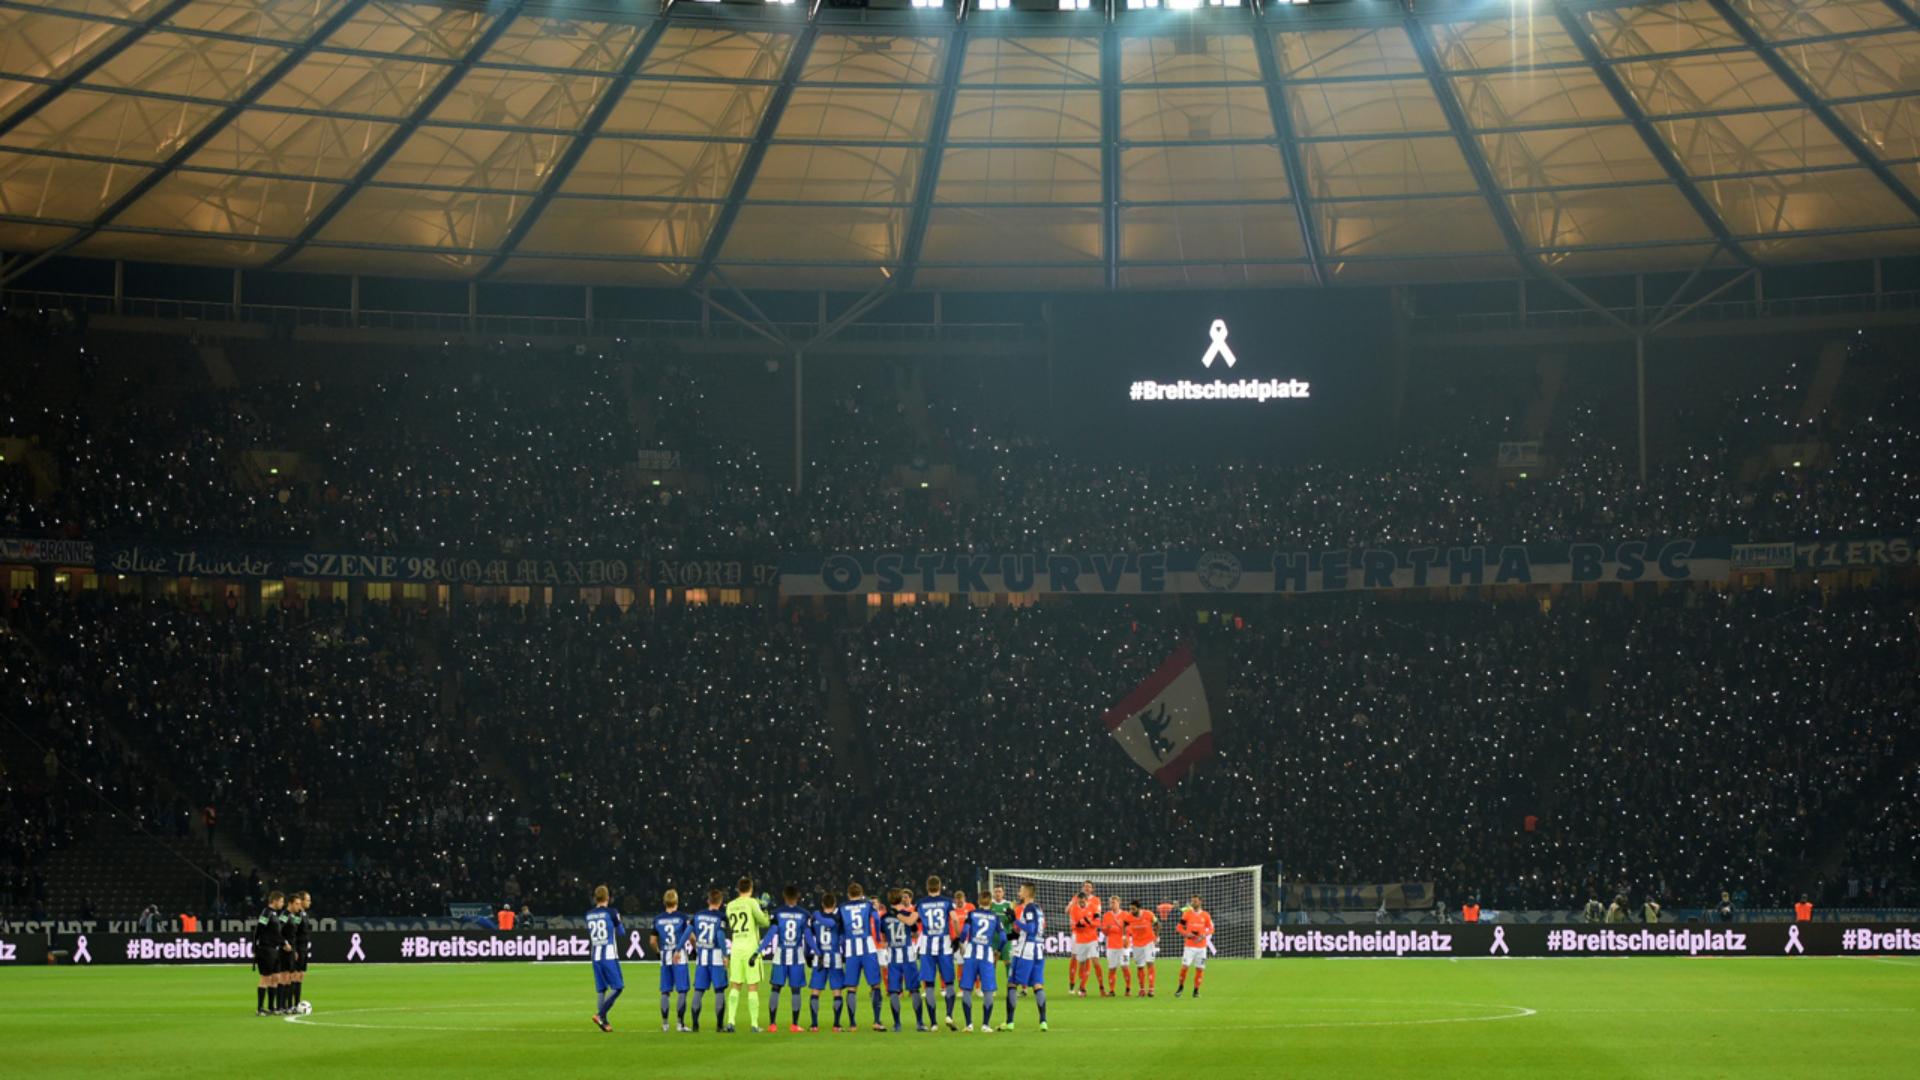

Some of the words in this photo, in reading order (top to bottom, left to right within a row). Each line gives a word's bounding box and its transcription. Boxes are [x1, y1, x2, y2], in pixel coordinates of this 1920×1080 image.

[1129, 379, 1310, 402] #Breitscheidplatz
[112, 547, 168, 573] Blue
[174, 551, 273, 576] Thunder
[657, 559, 743, 586] NORD
[820, 551, 1168, 593] OSTKURVE
[1272, 546, 1533, 593] HERTHA
[1568, 540, 1697, 582] BSC
[588, 918, 609, 941] 28
[729, 911, 750, 934] 22
[785, 919, 798, 942] 8
[851, 908, 864, 930] 5
[924, 908, 945, 930] 13
[977, 918, 990, 938] 2
[664, 923, 676, 946] 3
[697, 921, 716, 944] 21
[888, 923, 907, 945] 14
[1261, 929, 1453, 956] #Breitscheidplatz
[1546, 928, 1747, 955] #Breitscheidplatz
[400, 935, 590, 961] #Breitscheidplatz
